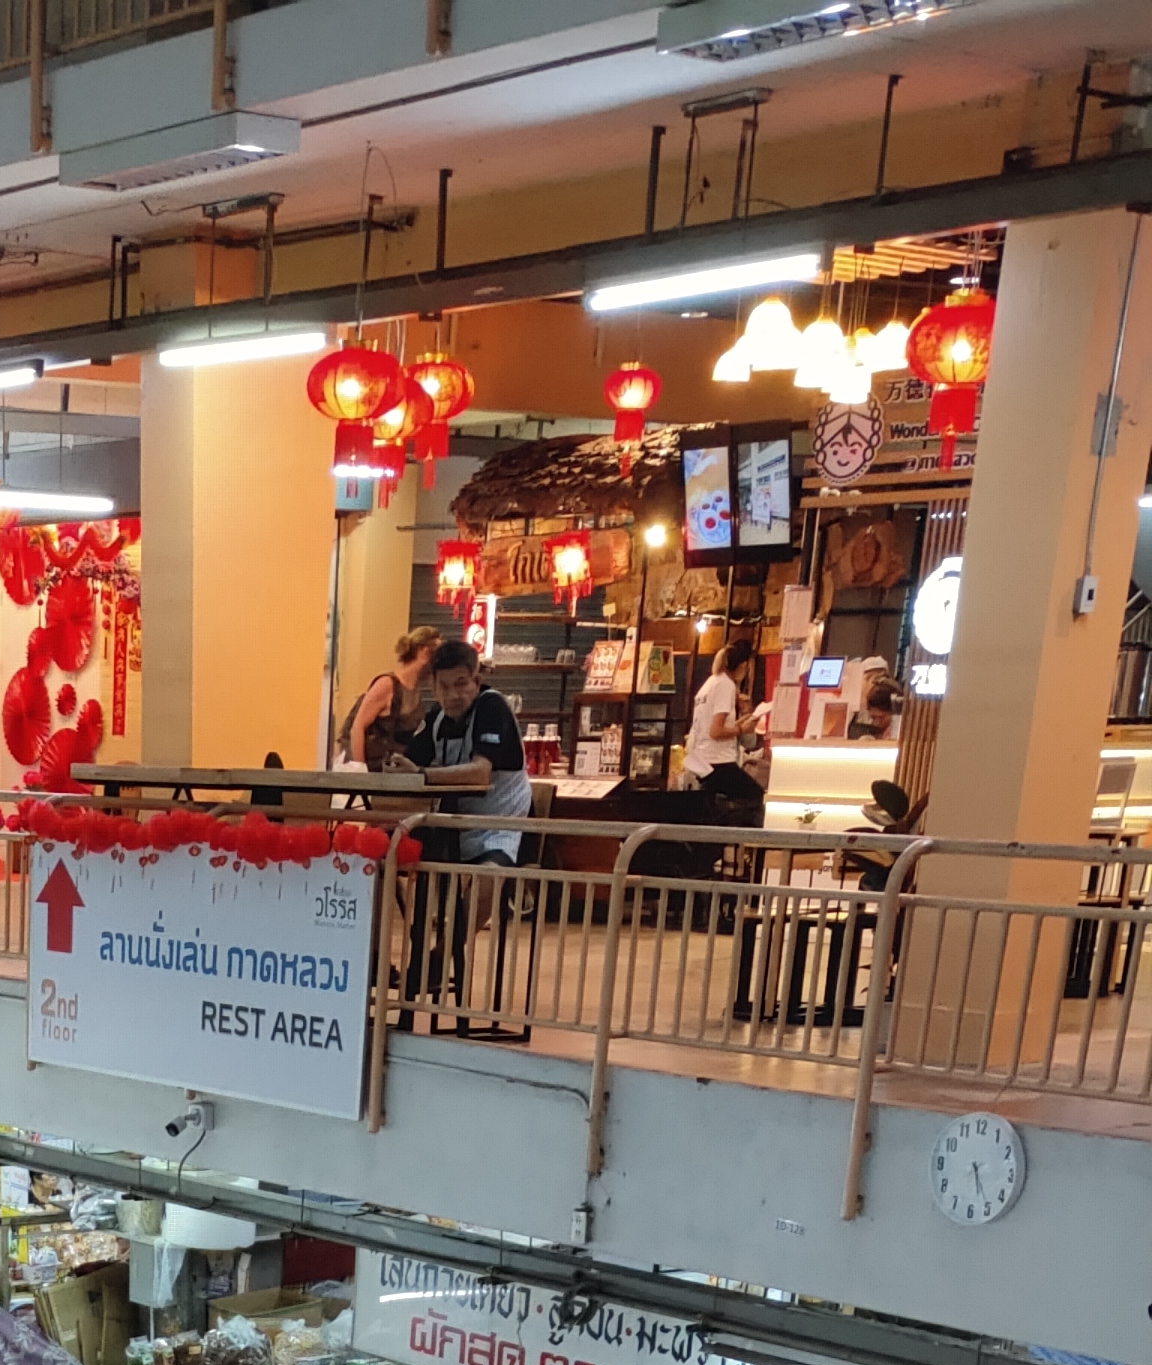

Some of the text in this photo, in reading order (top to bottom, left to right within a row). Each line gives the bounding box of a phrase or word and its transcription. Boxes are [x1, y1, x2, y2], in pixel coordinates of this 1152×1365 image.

[315, 886, 358, 920] วโรรส
[99, 910, 349, 993] ลานนั่งเล่น กาดหลวง
[41, 979, 79, 1021] 2nd
[41, 1018, 78, 1042] floor
[201, 1001, 343, 1052] REST AREA
[960, 1122, 970, 1138] 11
[976, 1119, 987, 1135] 12
[995, 1128, 1001, 1143] 1
[946, 1137, 957, 1152] 10
[1004, 1145, 1012, 1160] 2
[937, 1156, 944, 1171] 9
[1008, 1167, 1014, 1183] 3
[941, 1178, 948, 1193] 8
[952, 1195, 958, 1210] 7
[998, 1188, 1005, 1203] 4
[967, 1204, 974, 1219] 6
[983, 1201, 991, 1216] 5
